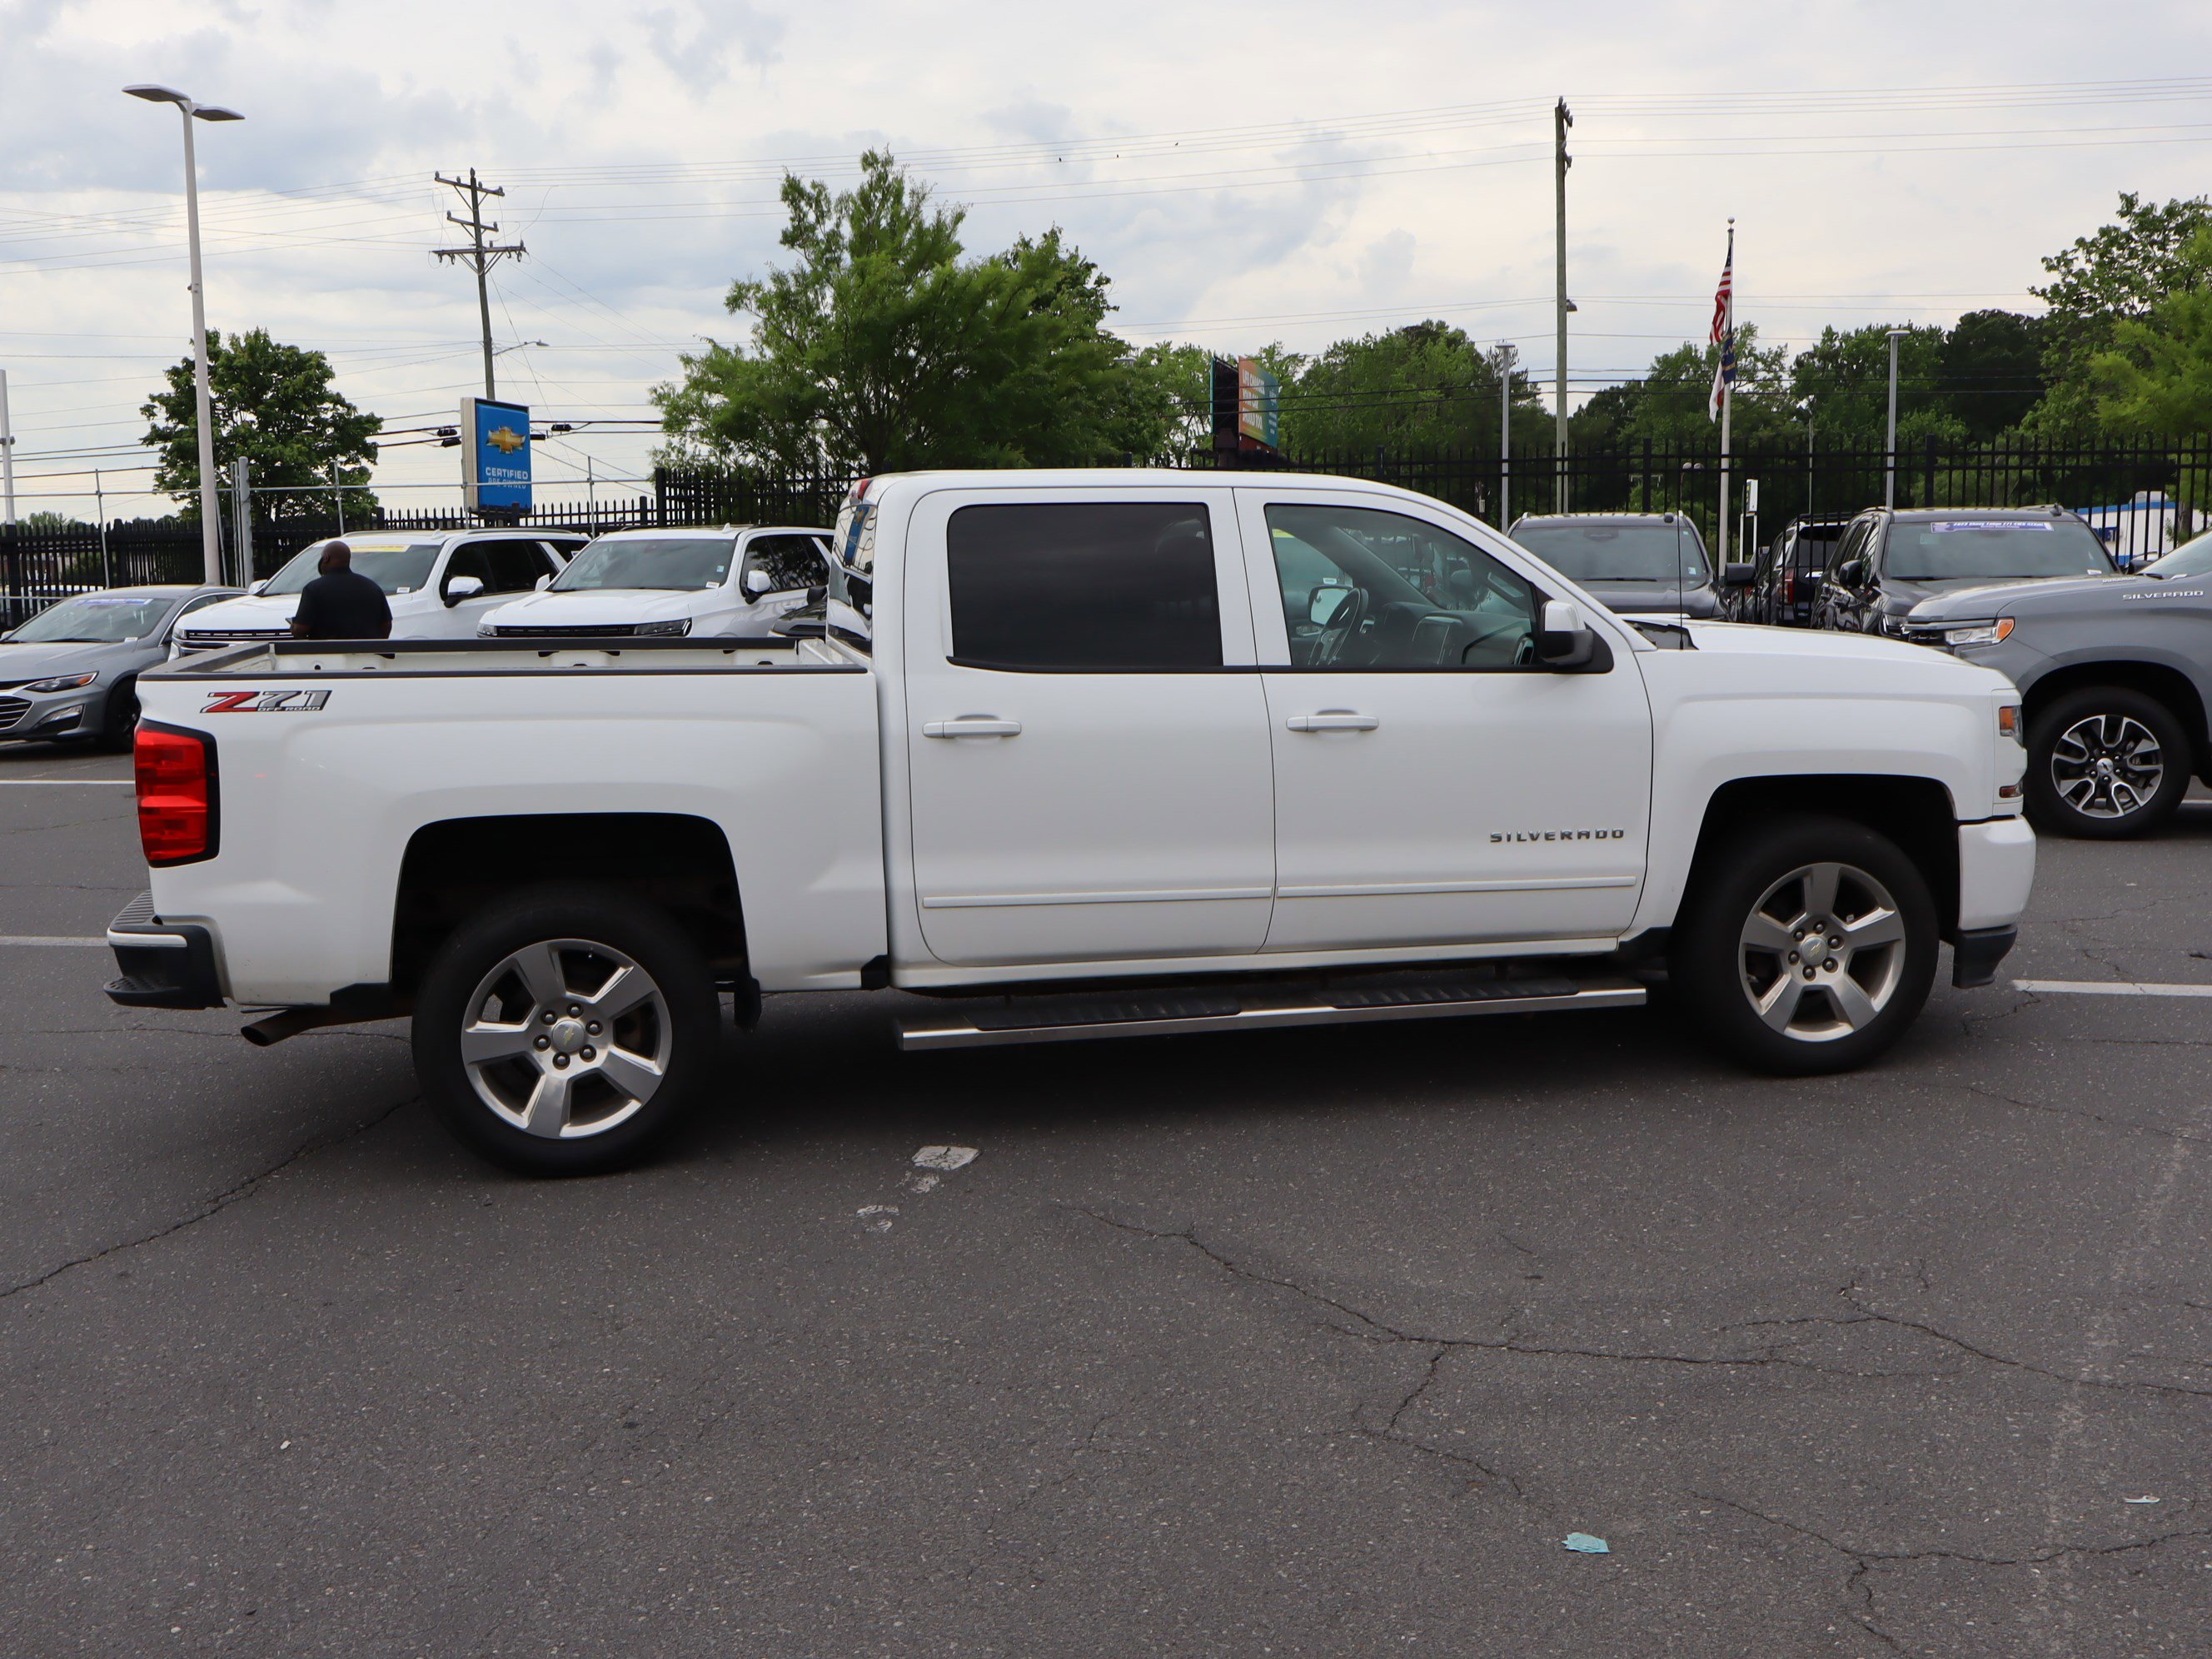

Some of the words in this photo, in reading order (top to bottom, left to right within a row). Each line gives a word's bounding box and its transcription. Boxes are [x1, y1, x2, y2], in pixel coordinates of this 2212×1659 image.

[486, 467, 528, 480] CERTIFIED
[2122, 590, 2205, 600] SILVERADO
[199, 690, 332, 714] Z71
[1490, 828, 1625, 843] SILVERADO
